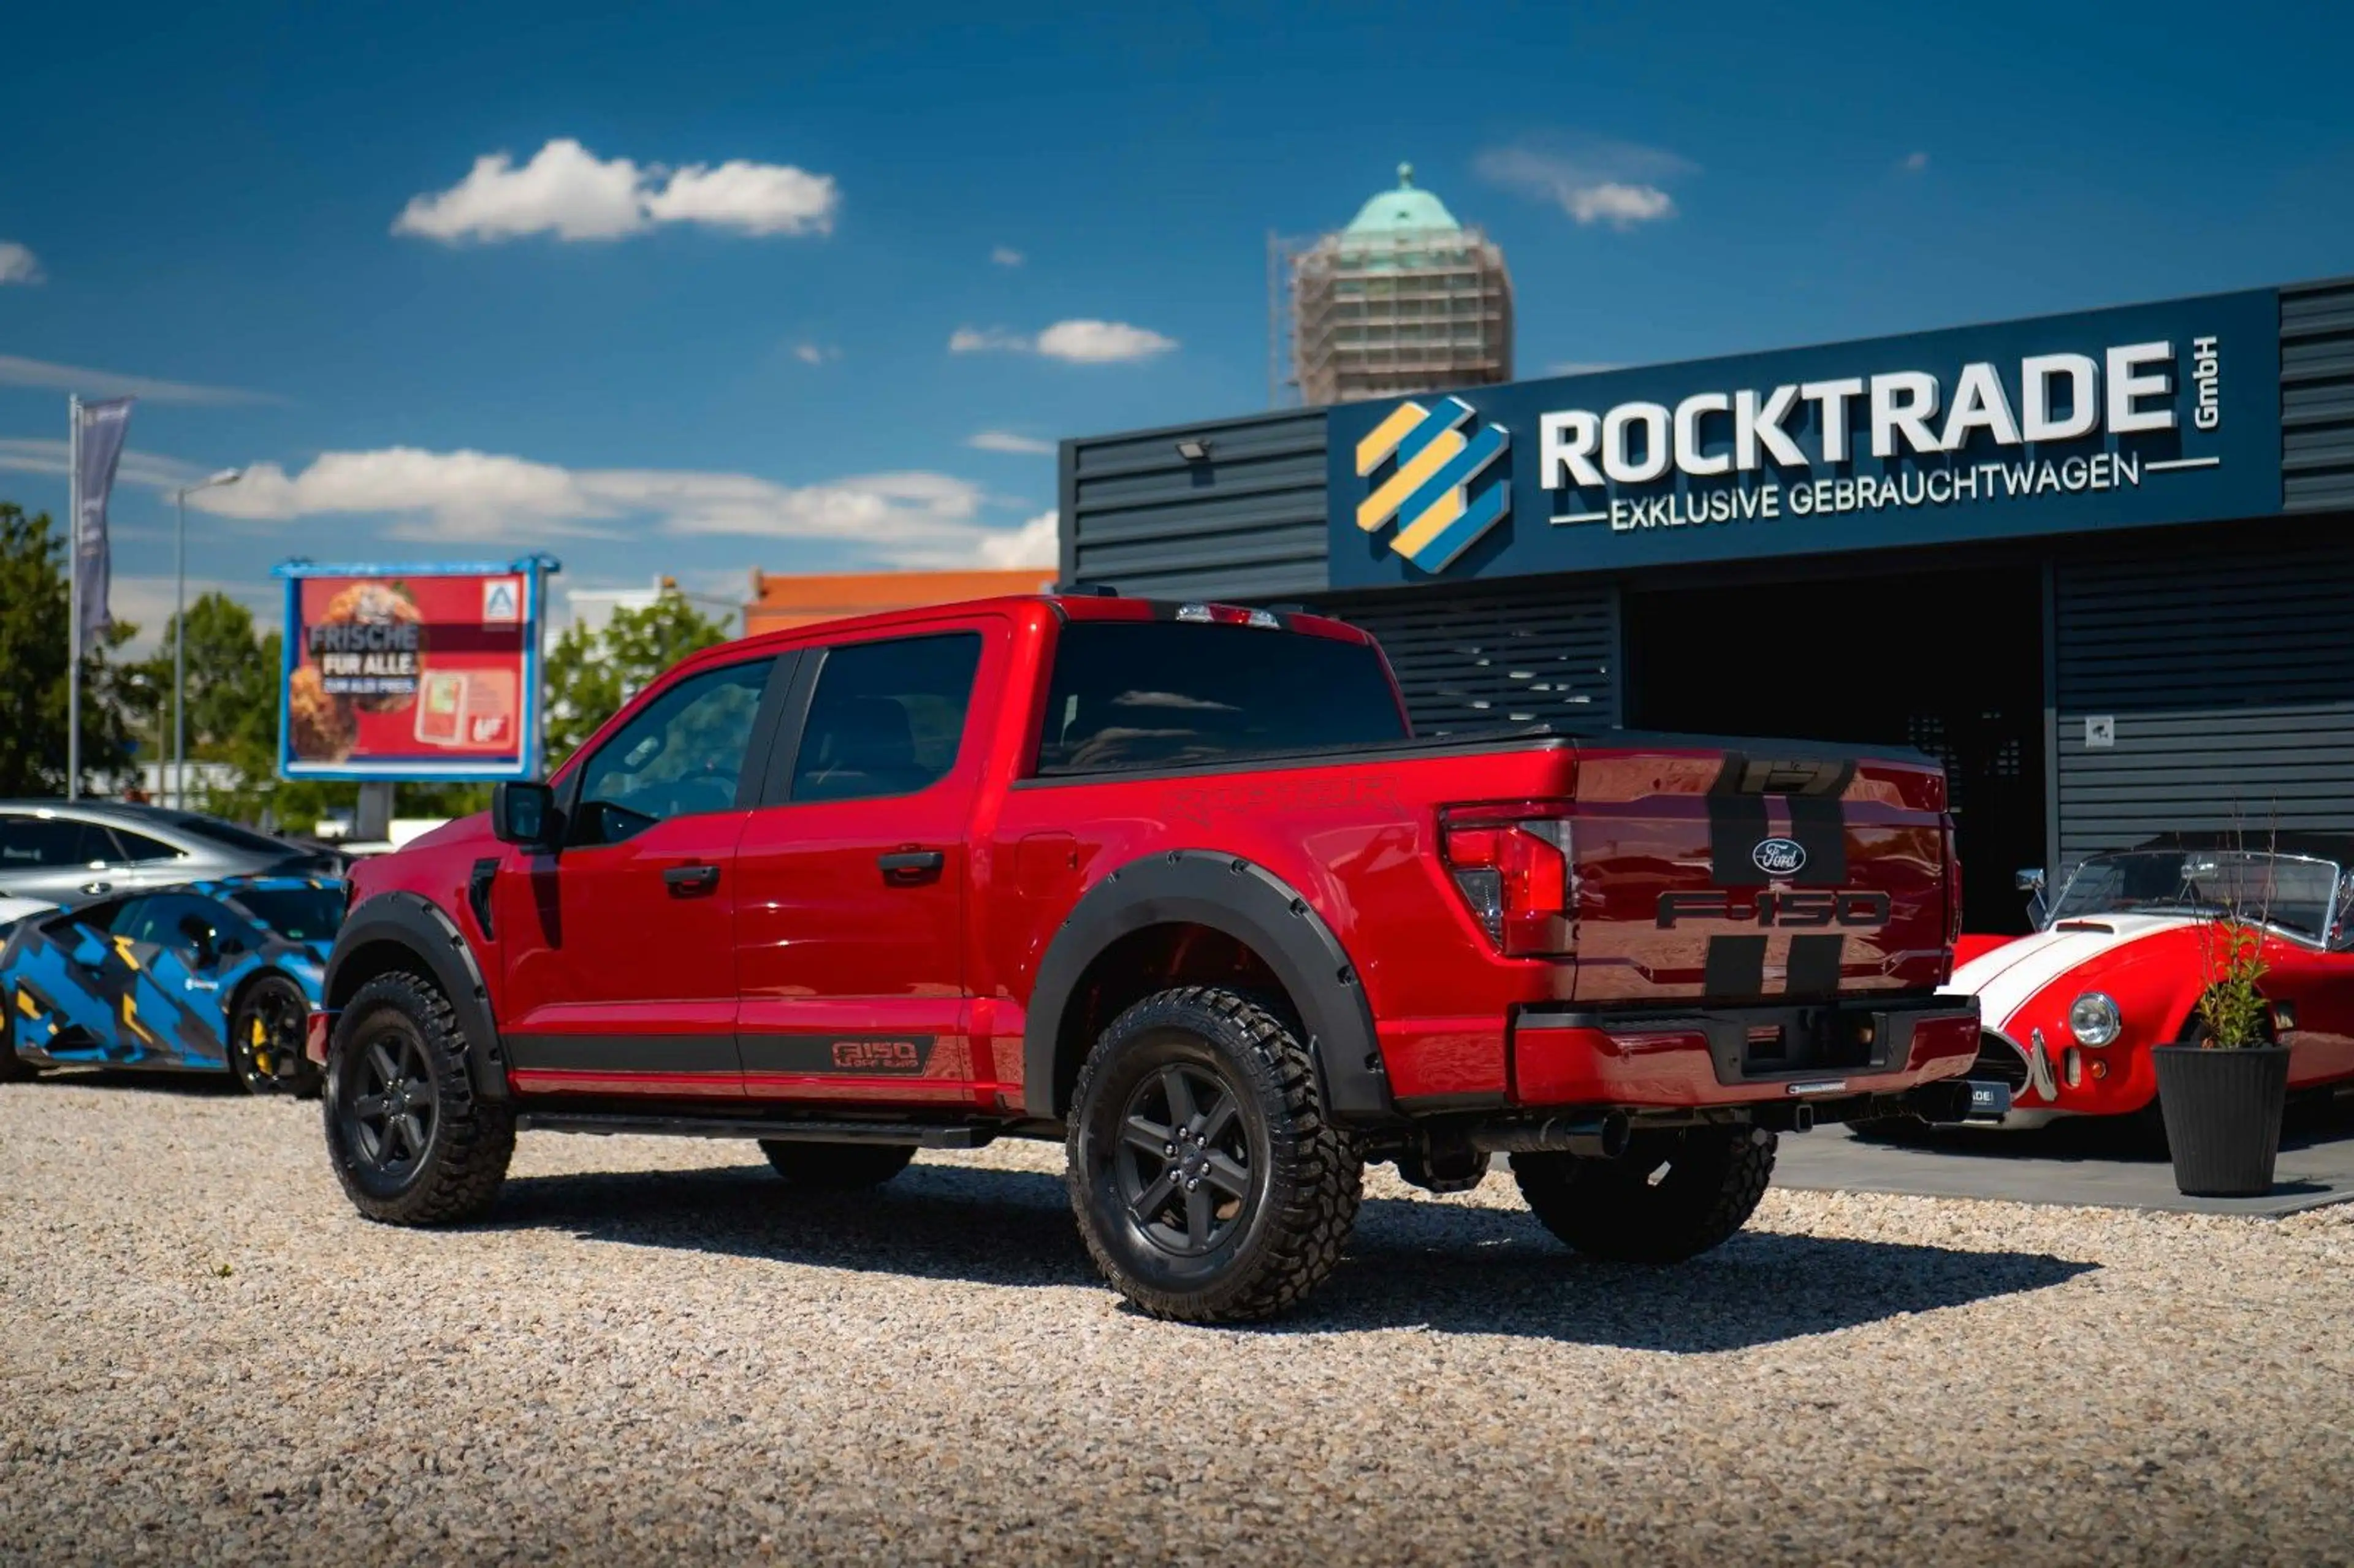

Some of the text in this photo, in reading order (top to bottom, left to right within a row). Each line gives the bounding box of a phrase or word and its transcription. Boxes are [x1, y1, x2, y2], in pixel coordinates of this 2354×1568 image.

[2193, 335, 2219, 429] GmbH
[1540, 340, 2178, 490] ROCKTRADE
[1611, 451, 2139, 530] EXKLUSIVE GEBRAUCHTWAGEN
[310, 624, 419, 651] FRISCHE
[1757, 843, 1797, 868] Ford
[1656, 890, 1891, 929] F-150
